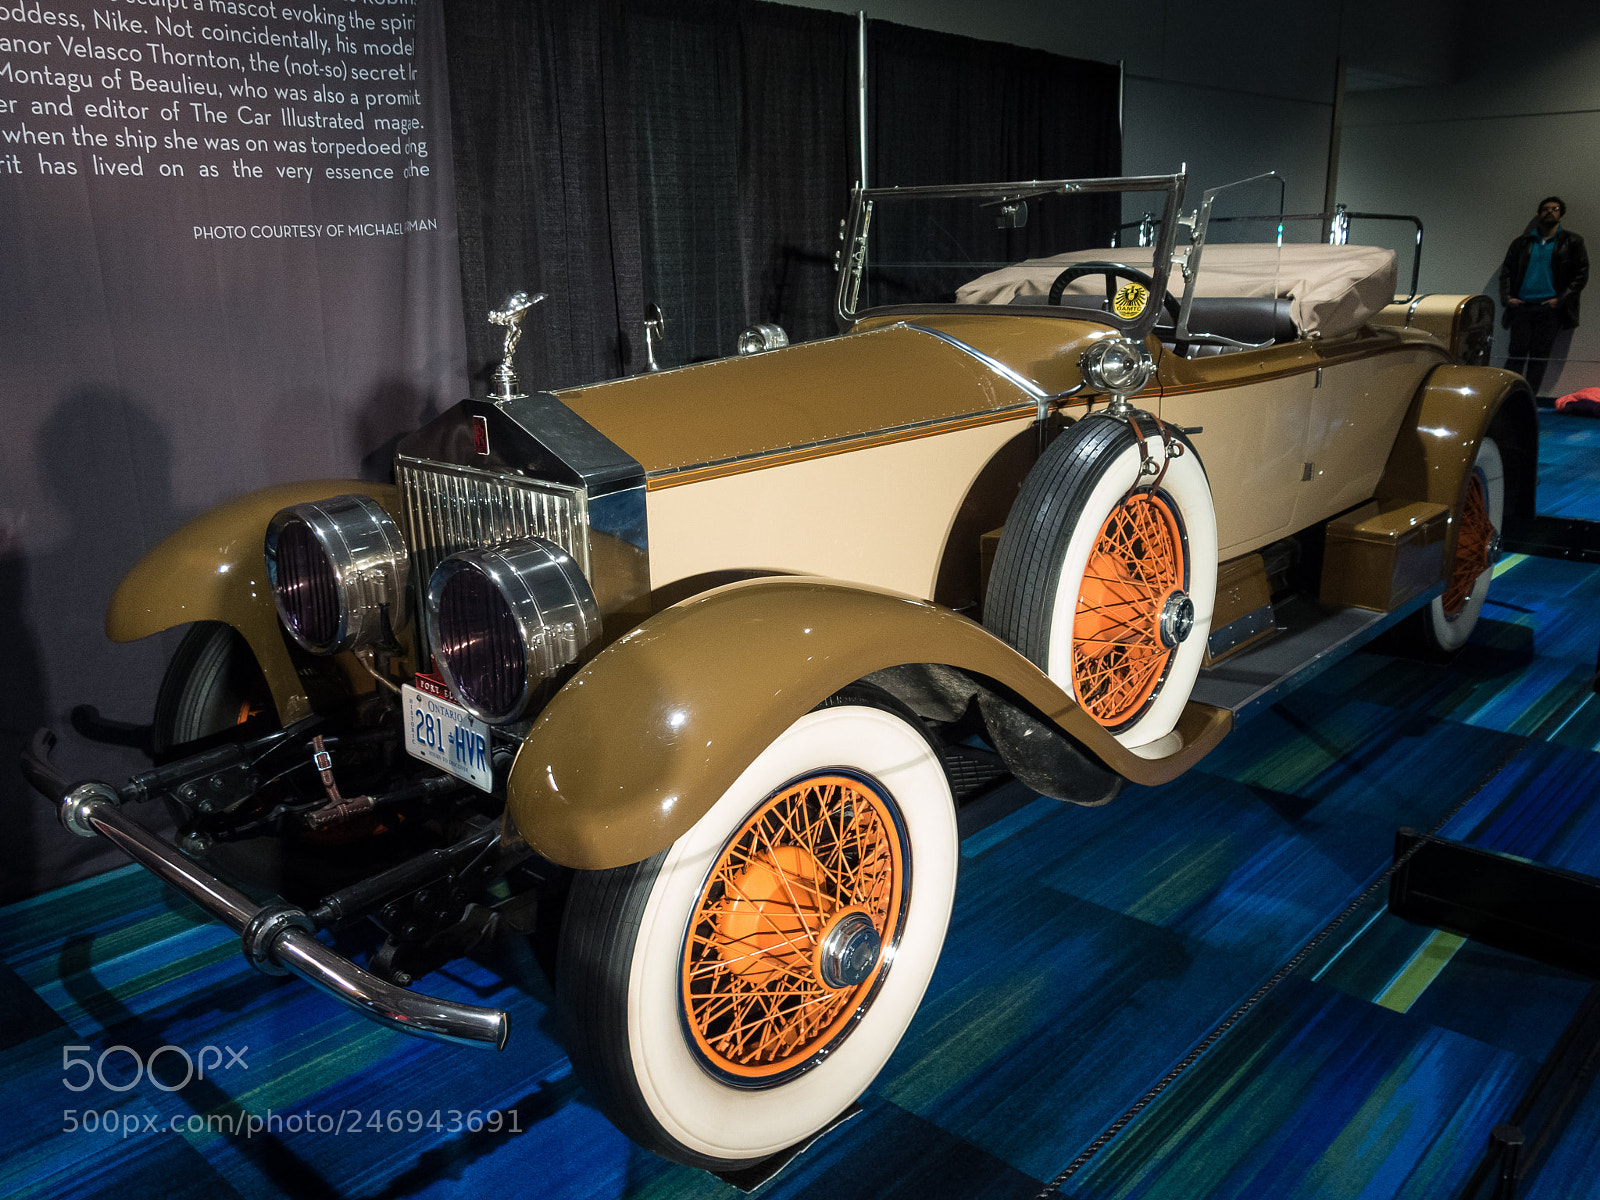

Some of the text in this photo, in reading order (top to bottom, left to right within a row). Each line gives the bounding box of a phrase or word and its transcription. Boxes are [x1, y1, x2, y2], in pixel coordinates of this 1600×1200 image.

[92, 8, 149, 35] Nike.
[154, 15, 195, 39] Not
[201, 23, 331, 57] coincidentally,
[335, 32, 358, 55] his
[363, 35, 415, 57] model
[193, 0, 204, 12] a
[209, 0, 278, 20] mascot
[281, 3, 347, 33] evoking
[348, 9, 376, 31] the
[0, 37, 52, 55] anor
[56, 34, 143, 63] Velasco
[145, 42, 245, 73] Thornton,
[248, 51, 280, 73] the
[283, 53, 348, 82] (not-so)
[351, 63, 407, 81] secret
[100, 67, 123, 90] of
[129, 69, 223, 99] Beaulieu,
[227, 77, 268, 99] who
[273, 87, 308, 102] was
[313, 83, 345, 104] also
[350, 93, 359, 105] a
[31, 93, 74, 117] and
[84, 96, 150, 120] editor
[160, 99, 181, 122] of
[188, 101, 228, 124] The
[237, 105, 272, 126] Car
[280, 106, 365, 131] Illustrated
[1, 121, 66, 146] when
[71, 124, 109, 147] the
[114, 125, 158, 154] ship
[163, 128, 199, 150] she
[203, 137, 241, 151] was
[245, 139, 269, 153] on
[272, 139, 307, 154] was
[310, 135, 402, 160] torpedoed
[37, 152, 78, 176] has
[92, 153, 144, 177] lived
[158, 163, 185, 177] on
[199, 164, 220, 178] as
[231, 157, 264, 179] the
[275, 166, 313, 185] very
[325, 167, 395, 180] essence
[193, 225, 247, 240] PHOTO
[249, 224, 323, 239] COURTESY
[325, 223, 345, 237] OF
[347, 222, 405, 237] MICHAEL
[427, 700, 463, 722] ONTARIO
[415, 709, 486, 773] 281 HVR
